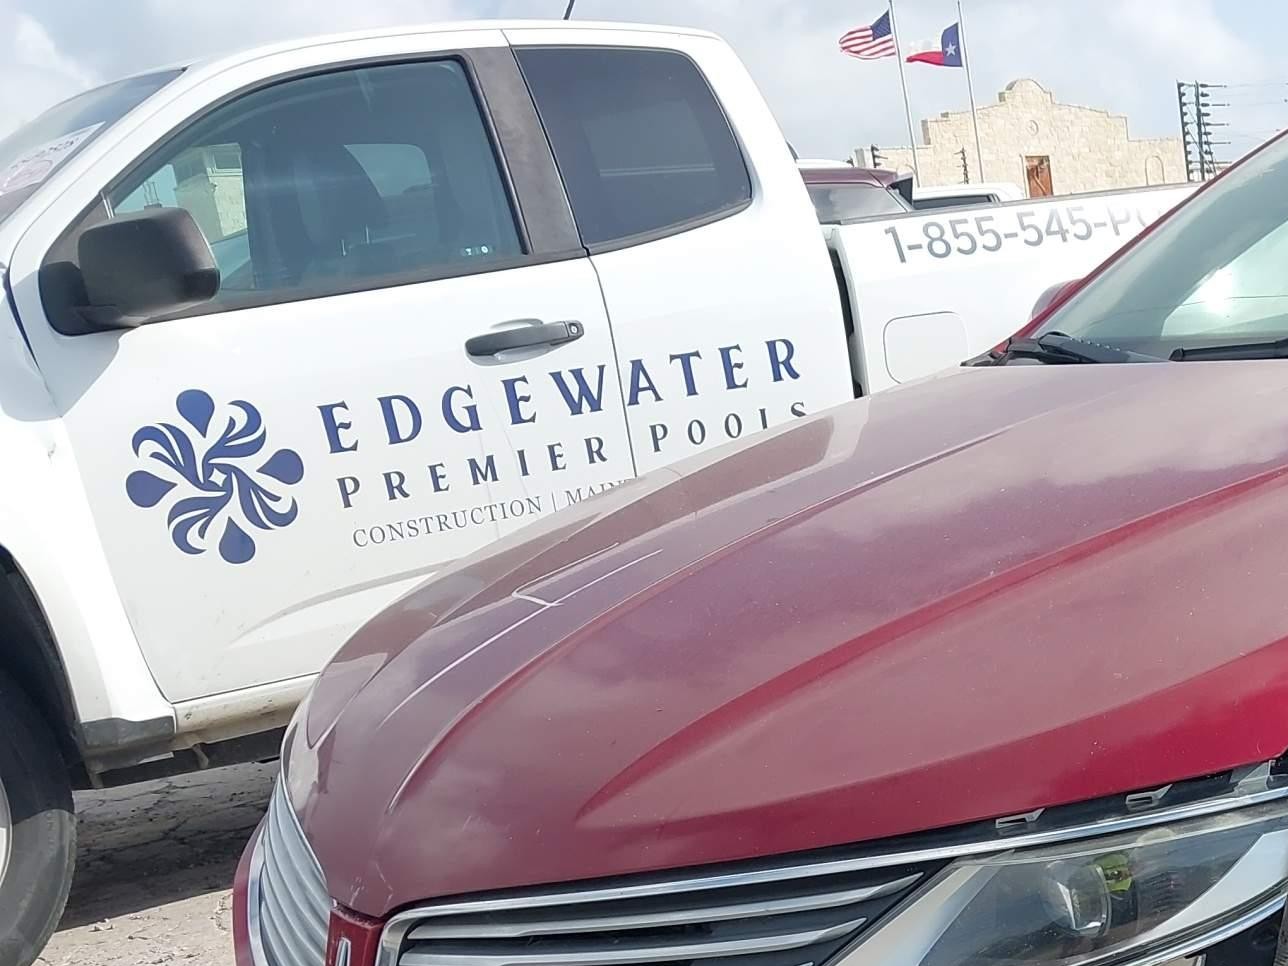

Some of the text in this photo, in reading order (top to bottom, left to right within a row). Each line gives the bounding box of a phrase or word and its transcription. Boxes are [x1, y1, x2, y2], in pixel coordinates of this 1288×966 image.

[317, 337, 801, 454] EDGEWATER
[336, 401, 807, 509] PREMIER POOLS
[352, 494, 542, 548] CONSTRUCTION
